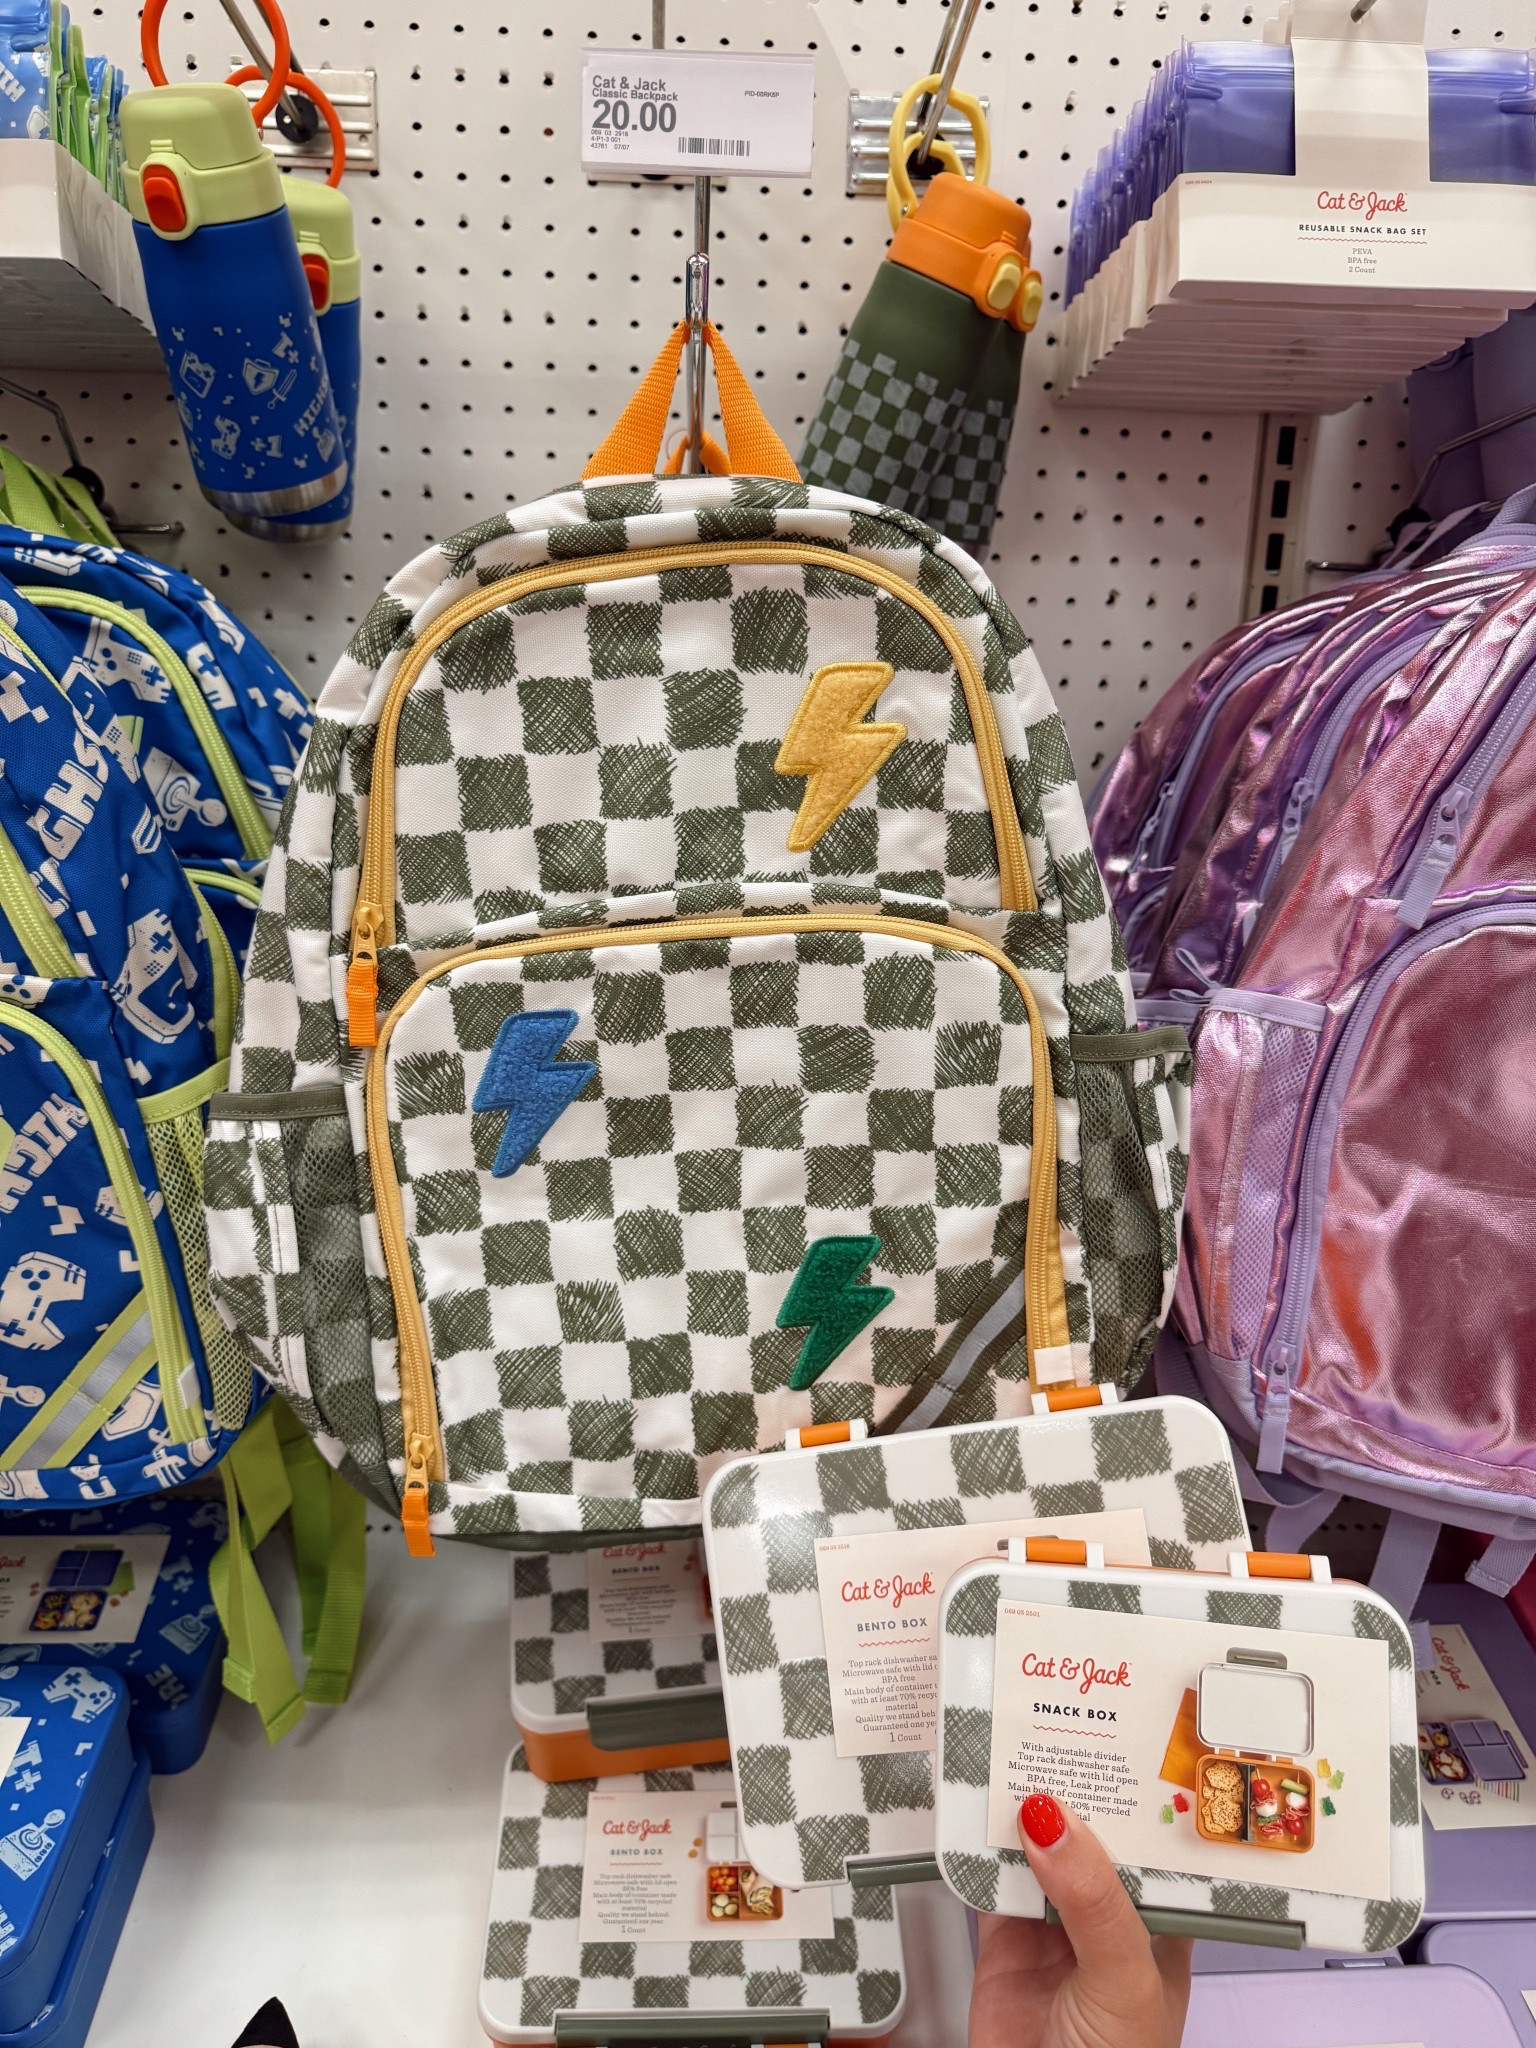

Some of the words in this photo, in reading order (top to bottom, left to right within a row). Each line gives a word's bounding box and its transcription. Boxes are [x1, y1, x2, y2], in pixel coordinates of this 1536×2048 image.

[592, 75, 616, 89] Cat
[620, 76, 630, 90] &
[634, 77, 667, 92] Jack
[592, 88, 628, 99] Classic
[630, 90, 678, 103] Backpack
[592, 98, 677, 133] 20.00
[614, 143, 630, 151] 07/07
[1317, 190, 1346, 210] Cat
[1348, 192, 1365, 210] &
[1365, 191, 1408, 221] Jack
[1299, 224, 1346, 233] REUSABLE
[1350, 225, 1382, 234] SNACK
[1387, 227, 1407, 235] BAG
[1411, 228, 1427, 236] SET
[1352, 247, 1373, 255] PEVA
[1348, 256, 1362, 264] BPA
[1354, 266, 1376, 274] Count
[841, 1580, 871, 1602] Cat
[874, 1578, 891, 1599] &
[892, 1572, 936, 1608] Jack
[857, 1619, 896, 1633] BENTO
[902, 1617, 928, 1629] BOX
[848, 1660, 864, 1668] Top
[865, 1657, 882, 1666] rack
[883, 1655, 928, 1665] dishwasher
[842, 1668, 884, 1678] Microwave
[885, 1665, 902, 1673] safe
[903, 1663, 921, 1673] with
[922, 1662, 933, 1671] lid
[1022, 1653, 1056, 1678] Cat
[1059, 1657, 1081, 1680] &
[1080, 1658, 1132, 1694] Jack
[882, 1675, 899, 1684] BPA
[900, 1674, 916, 1682] free
[844, 1687, 865, 1696] Main
[865, 1686, 885, 1695] body
[886, 1684, 895, 1693] of
[895, 1682, 933, 1692] container
[851, 1696, 869, 1705] with
[870, 1696, 878, 1704] at
[879, 1694, 898, 1703] least
[899, 1692, 917, 1701] 70%
[885, 1701, 918, 1712] material
[1033, 1702, 1081, 1718] SNACK
[1087, 1709, 1118, 1722] BOX
[855, 1714, 884, 1724] Quality
[898, 1711, 920, 1720] stand
[863, 1721, 909, 1732] Guaranteed
[889, 1731, 896, 1743] 1
[897, 1733, 922, 1742] Count
[1021, 1741, 1044, 1752] With
[1045, 1744, 1092, 1758] adjustable
[1094, 1751, 1127, 1763] divider
[1017, 1751, 1035, 1763] Top
[1036, 1754, 1056, 1764] rack
[1058, 1757, 1110, 1771] dishwasher
[1111, 1764, 1130, 1774] safe
[1008, 1760, 1058, 1775] Microwave
[1059, 1768, 1078, 1777] safe
[1080, 1770, 1101, 1781] with
[1102, 1772, 1115, 1783] lid
[1116, 1776, 1139, 1786] open
[1027, 1773, 1046, 1784] BPA
[1070, 1779, 1093, 1790] Leak
[1094, 1784, 1120, 1794] proof
[1007, 1782, 1031, 1793] Main
[1033, 1785, 1054, 1796] body
[1056, 1788, 1067, 1797] of
[1067, 1790, 1112, 1804] container
[1113, 1797, 1138, 1807] made
[1070, 1801, 1090, 1811] 50%
[1092, 1803, 1131, 1817] recycled
[602, 1820, 624, 1835] Cat
[626, 1820, 640, 1834] &
[639, 1818, 673, 1841] Jack
[610, 1848, 641, 1856] BENTO
[643, 1848, 664, 1856] BOX
